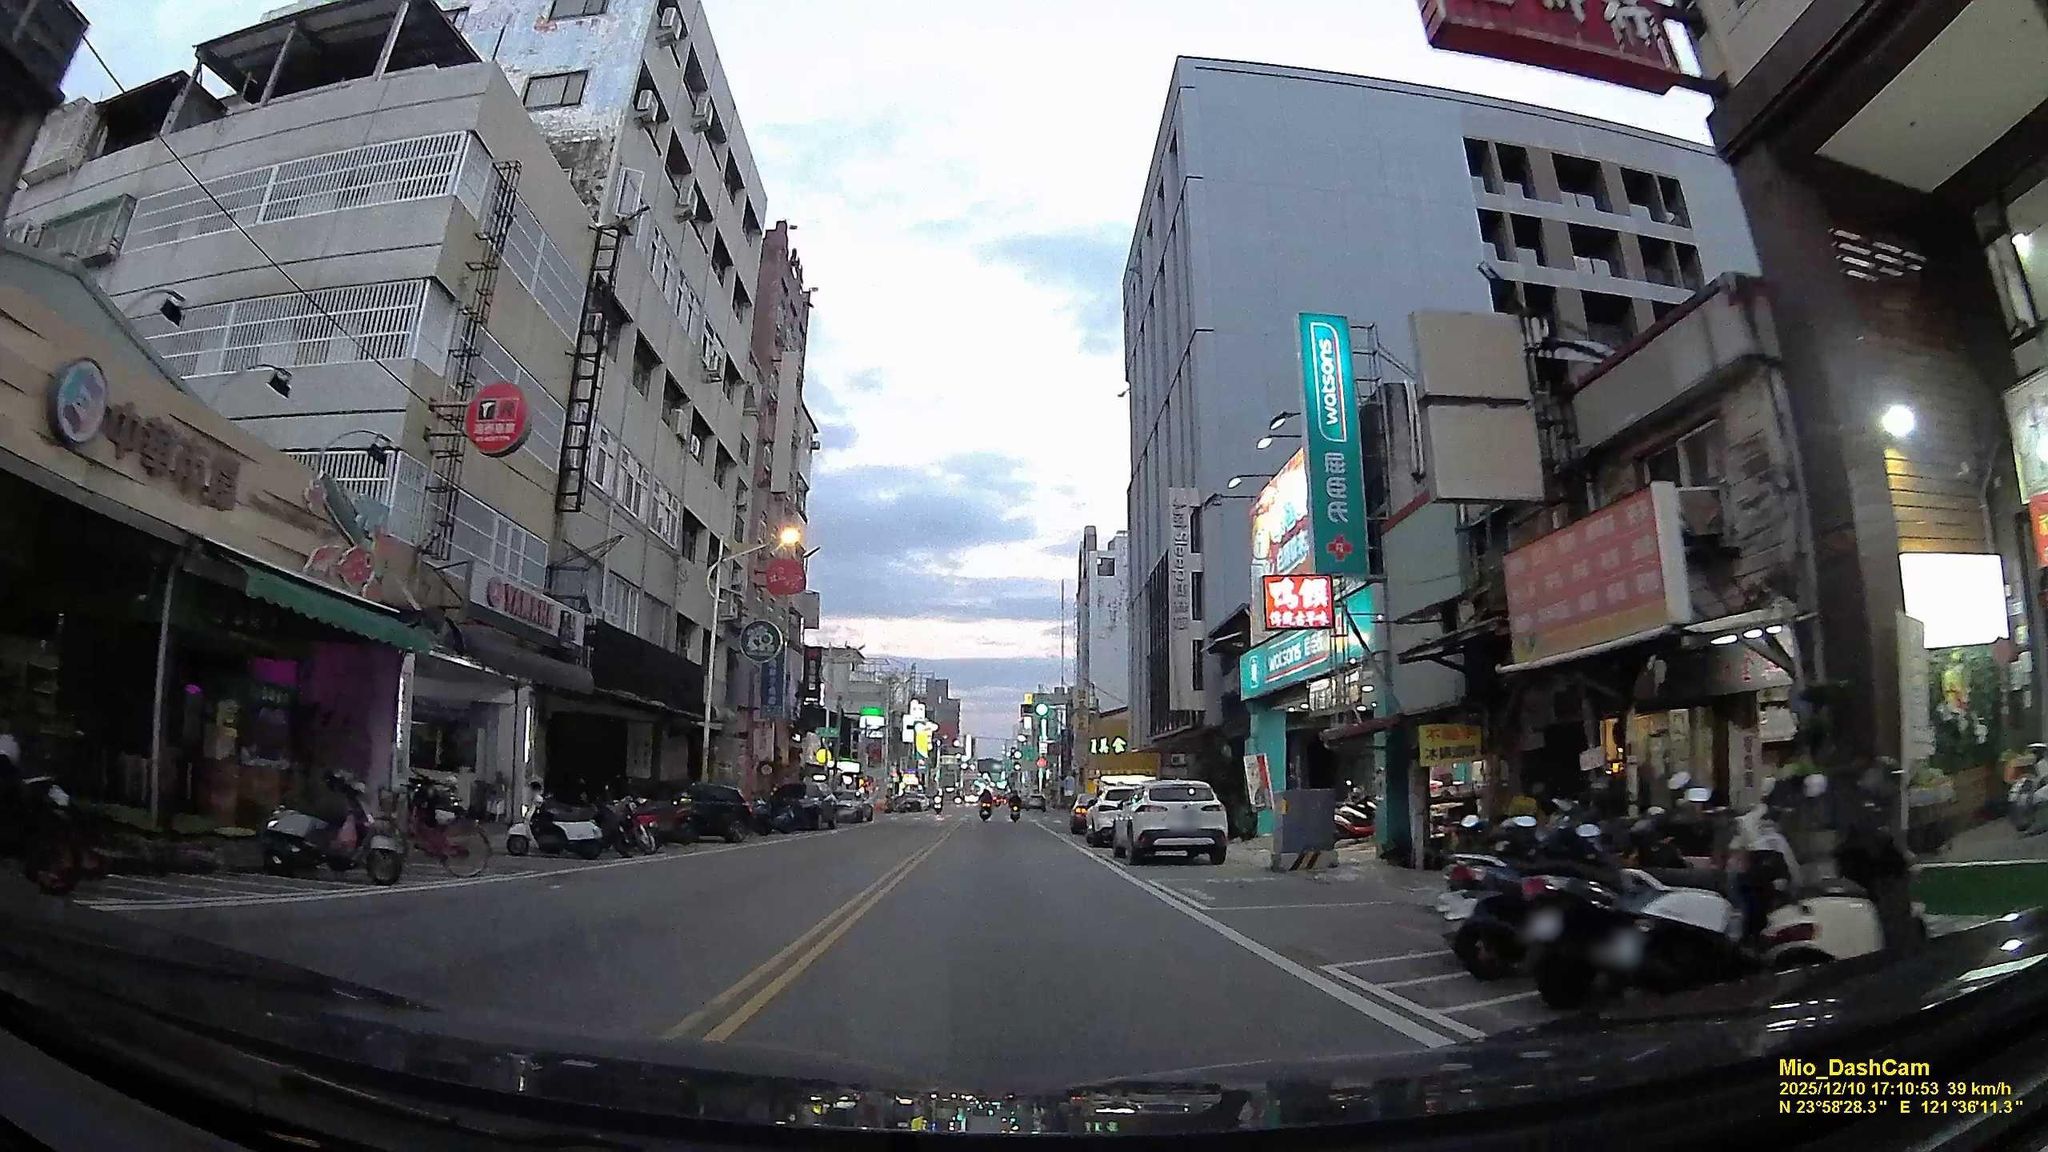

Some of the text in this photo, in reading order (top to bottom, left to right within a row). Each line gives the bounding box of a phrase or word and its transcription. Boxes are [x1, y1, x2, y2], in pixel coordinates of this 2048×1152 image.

[1318, 338, 1339, 426] watsons
[1324, 451, 1349, 524] 屈臣氏
